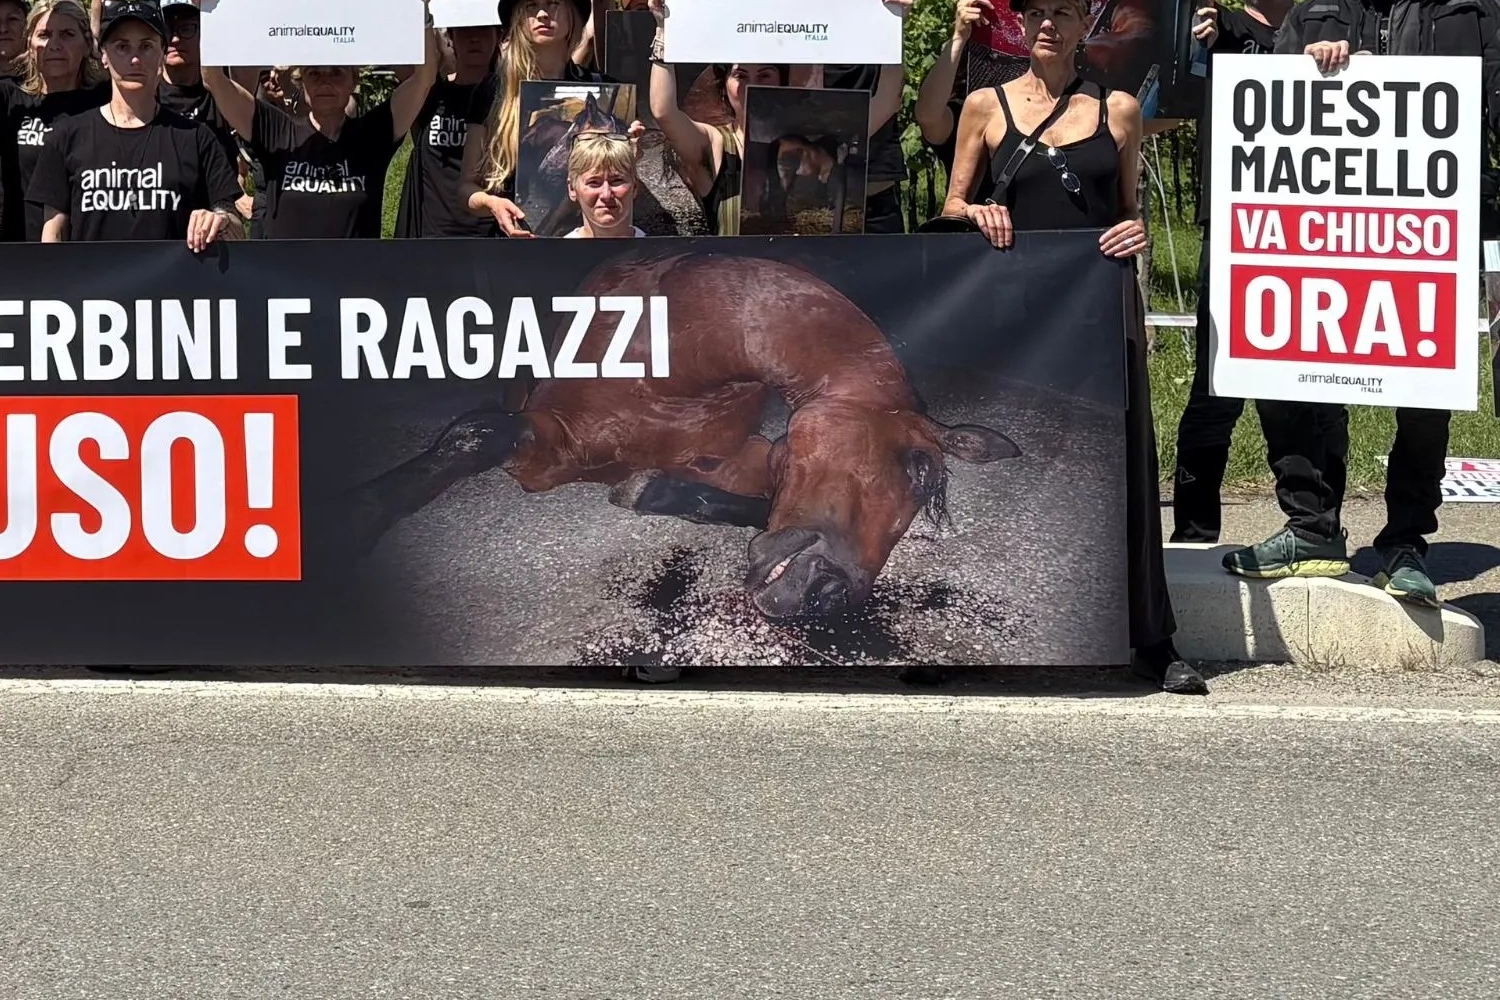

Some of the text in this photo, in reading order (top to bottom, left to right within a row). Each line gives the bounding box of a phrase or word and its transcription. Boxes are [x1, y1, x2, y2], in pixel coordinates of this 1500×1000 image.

[269, 25, 354, 36] animalEQUALITY
[737, 21, 828, 33] animalEQUALITY
[1233, 79, 1459, 142] QUESTO
[81, 161, 162, 191] animal
[281, 175, 367, 194] EQUALITY
[1232, 146, 1458, 198] MACELLO
[81, 189, 181, 212] EQUALITY
[1237, 209, 1451, 257] VA CHIUSO
[1245, 275, 1439, 358] ORA!
[268, 299, 312, 379] E
[340, 296, 669, 382] RAGAZZI
[1298, 371, 1383, 388] animalEQUALITY
